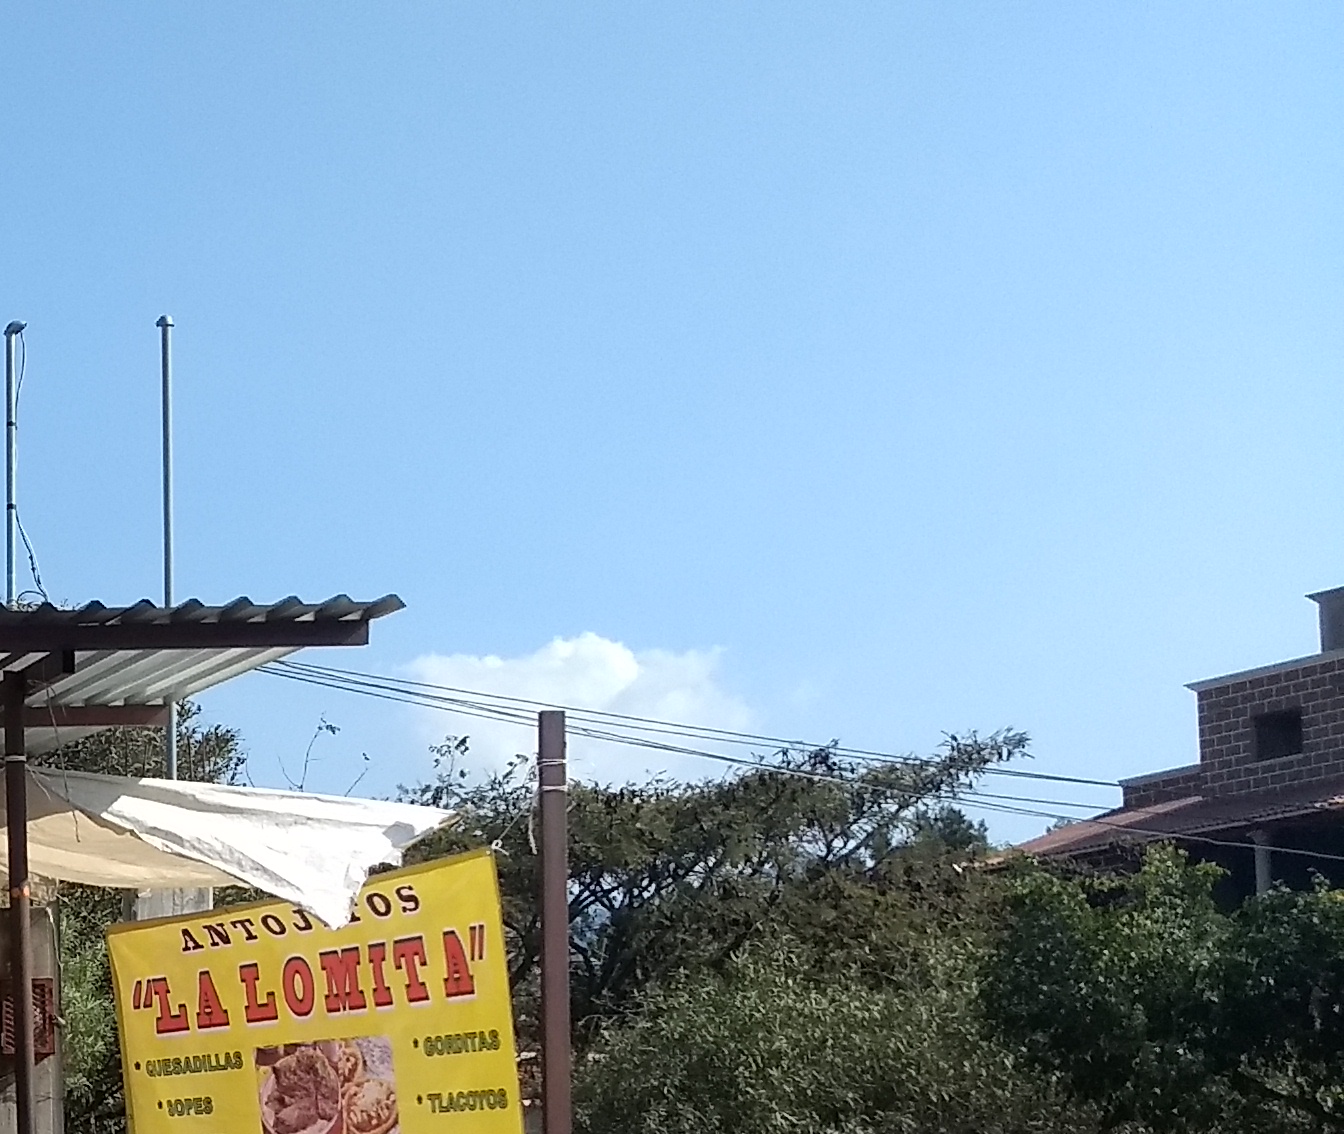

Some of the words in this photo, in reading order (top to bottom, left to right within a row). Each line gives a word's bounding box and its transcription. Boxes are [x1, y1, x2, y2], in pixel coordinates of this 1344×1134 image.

[180, 885, 421, 951] ANTOJOS
[423, 1029, 500, 1056] GORDITAS
[145, 1051, 243, 1077] QUESADILLAS
[166, 1097, 214, 1117] SOPES
[427, 1088, 508, 1113] TLACOYOS
